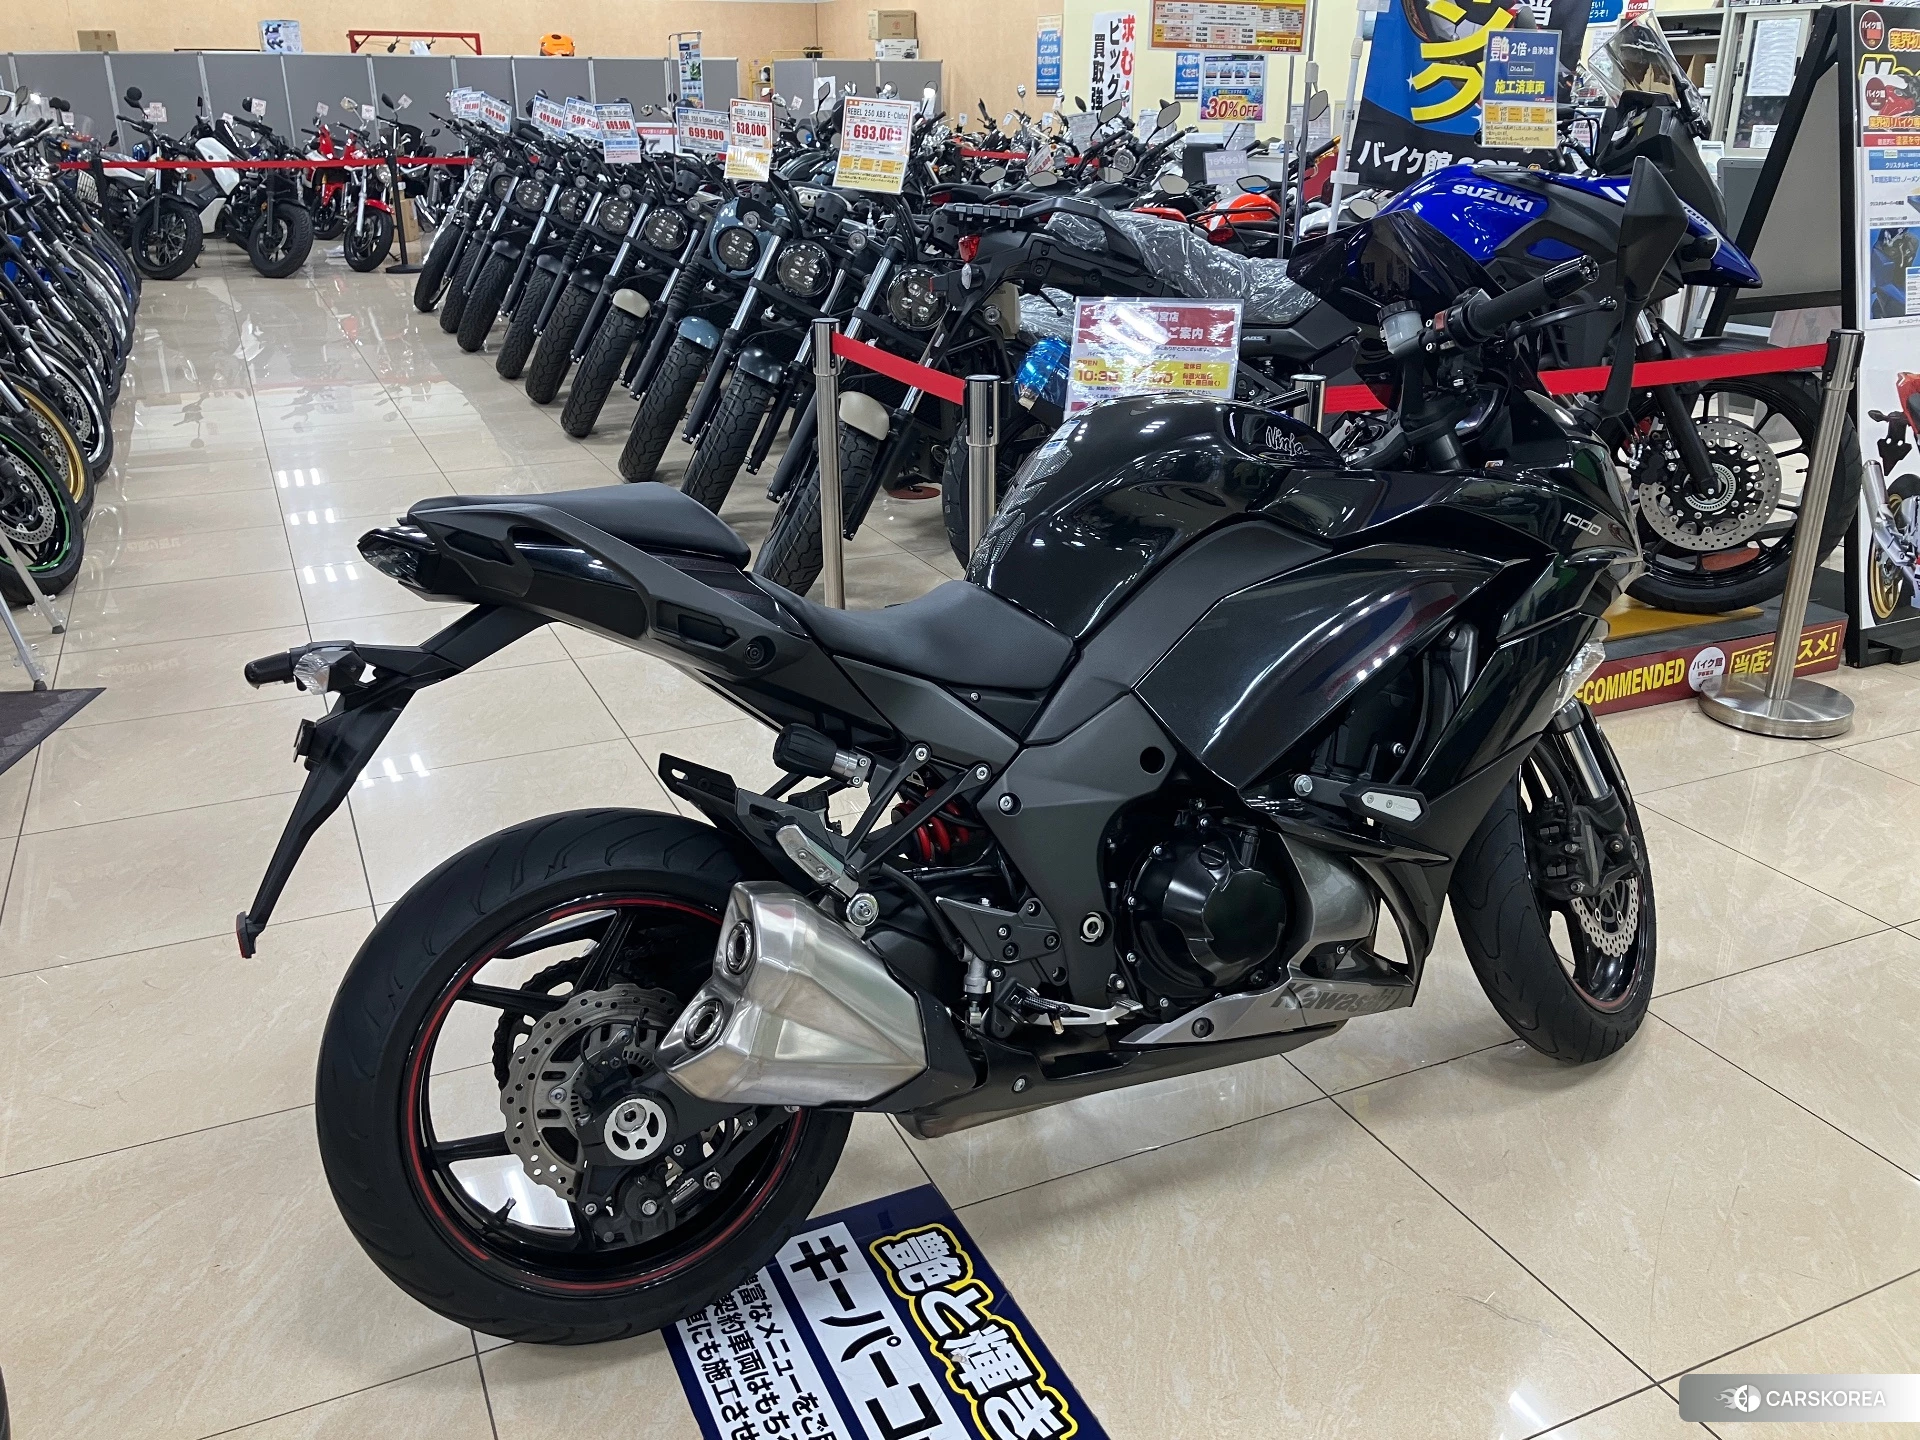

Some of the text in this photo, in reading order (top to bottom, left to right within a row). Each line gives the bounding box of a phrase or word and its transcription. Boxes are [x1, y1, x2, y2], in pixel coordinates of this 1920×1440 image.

[1091, 34, 1105, 121] 買取強
[1494, 79, 1546, 95] 施工済車両
[848, 107, 863, 116] REBEL
[864, 109, 875, 117] 250
[876, 110, 886, 118] ABS
[1207, 98, 1258, 118] 30% OFF
[689, 127, 724, 140] 699,900
[736, 122, 767, 137] 638,000
[1452, 184, 1534, 213] SUZUKI
[1266, 426, 1310, 456] Ninja
[1563, 512, 1602, 536] 1000
[789, 1235, 943, 1440] キーパーコ
